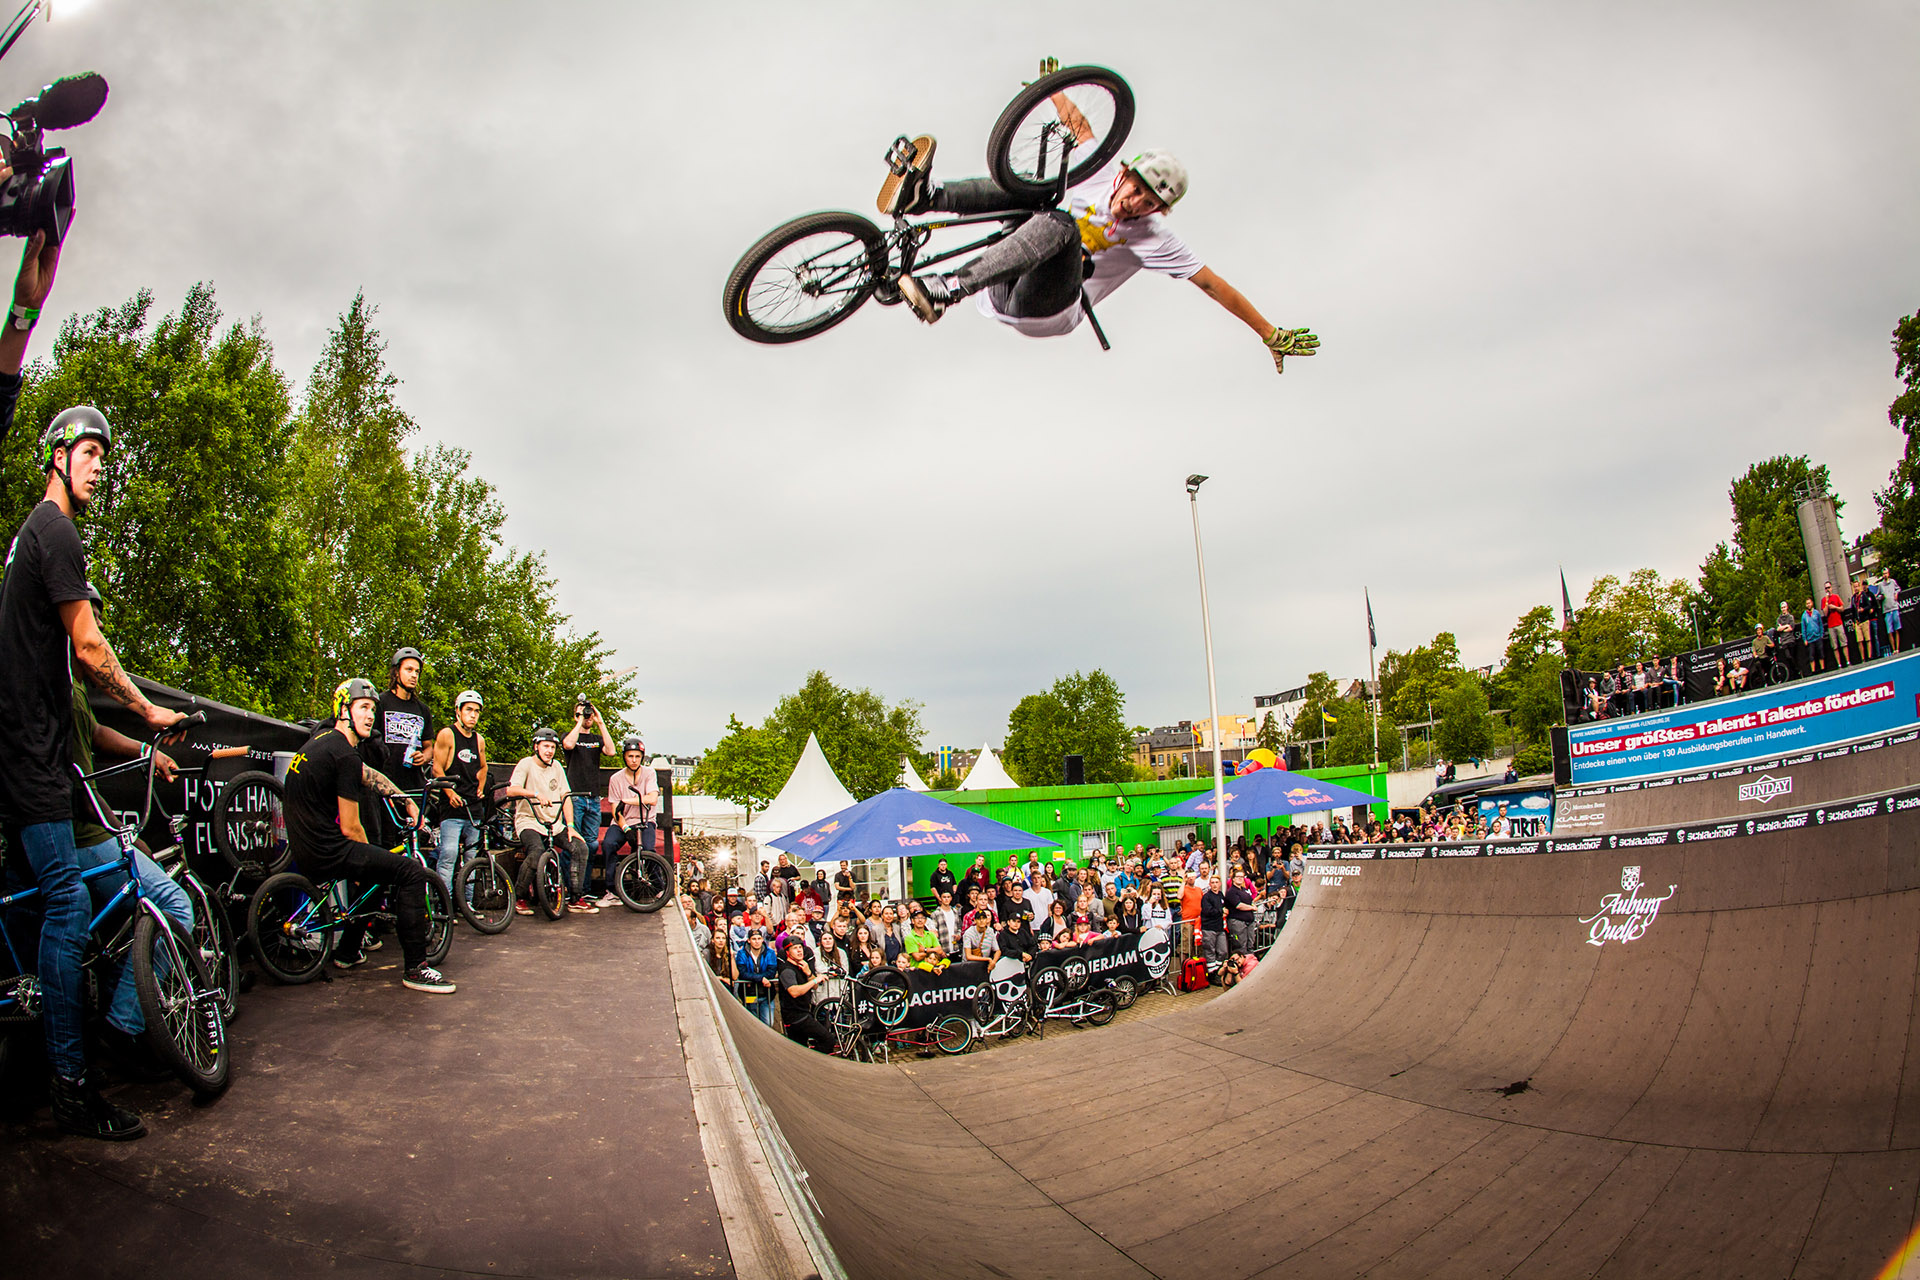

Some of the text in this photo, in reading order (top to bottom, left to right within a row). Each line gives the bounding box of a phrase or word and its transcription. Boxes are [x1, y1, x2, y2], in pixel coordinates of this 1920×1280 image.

[1572, 685, 1895, 756] Unser größtes Talent: Talente fördern.
[1574, 725, 1807, 771] Entdecke einen von über 130 Ausbildungsberufen im Handwerk.
[1740, 780, 1790, 799] SUNDAY
[896, 833, 971, 848] Red Bull
[1308, 866, 1361, 876] FLENSBURGER
[1320, 877, 1343, 887] MALZ
[1585, 914, 1646, 947] Quelle
